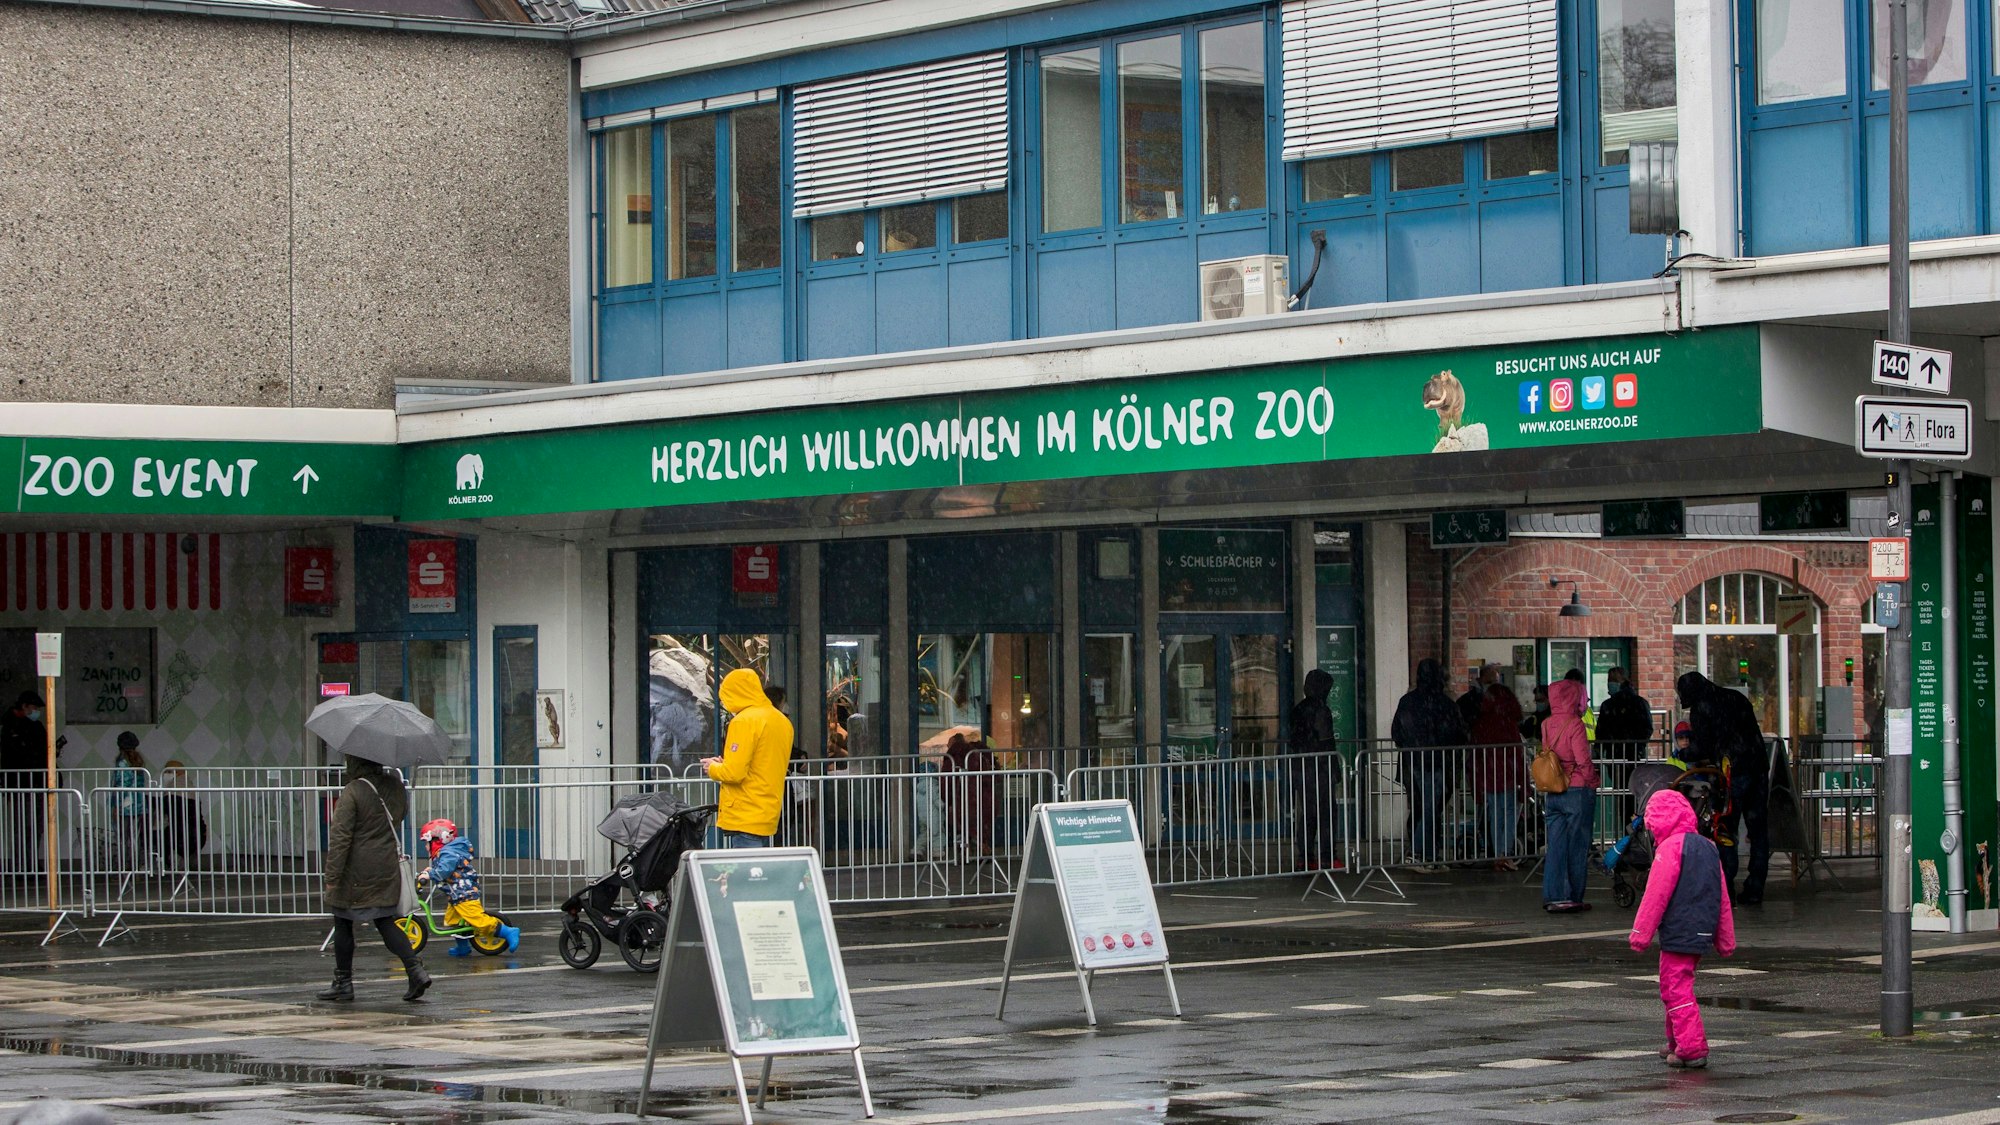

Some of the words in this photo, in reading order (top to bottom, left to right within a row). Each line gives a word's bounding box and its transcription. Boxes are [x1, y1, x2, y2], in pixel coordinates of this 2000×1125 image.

[1495, 356, 1556, 375] BESUCHT
[1559, 354, 1588, 370] UNS
[1591, 351, 1630, 368] AUCH
[1633, 348, 1662, 365] AUF
[1881, 354, 1909, 376] 140
[1518, 415, 1638, 434] WWW.KOELNERZOO.DE
[1926, 419, 1955, 439] Flora
[652, 434, 787, 483] HERZLICH
[802, 416, 1020, 473] WILLKOMMEN
[1037, 409, 1076, 455] IM
[1093, 393, 1235, 452] KÖLNER
[1255, 386, 1335, 440] ZOO
[24, 455, 115, 497] ZOO
[132, 457, 258, 498] EVENT
[1887, 474, 1893, 485] 3
[448, 495, 477, 505] KÖLNER
[478, 494, 494, 503] ZOO
[1872, 543, 1892, 553] H200
[81, 666, 141, 682] ZANFINO
[101, 682, 122, 695] AM
[95, 695, 129, 713] ZOO
[1055, 815, 1087, 828] Wichtige
[1088, 814, 1122, 826] Hinweise
